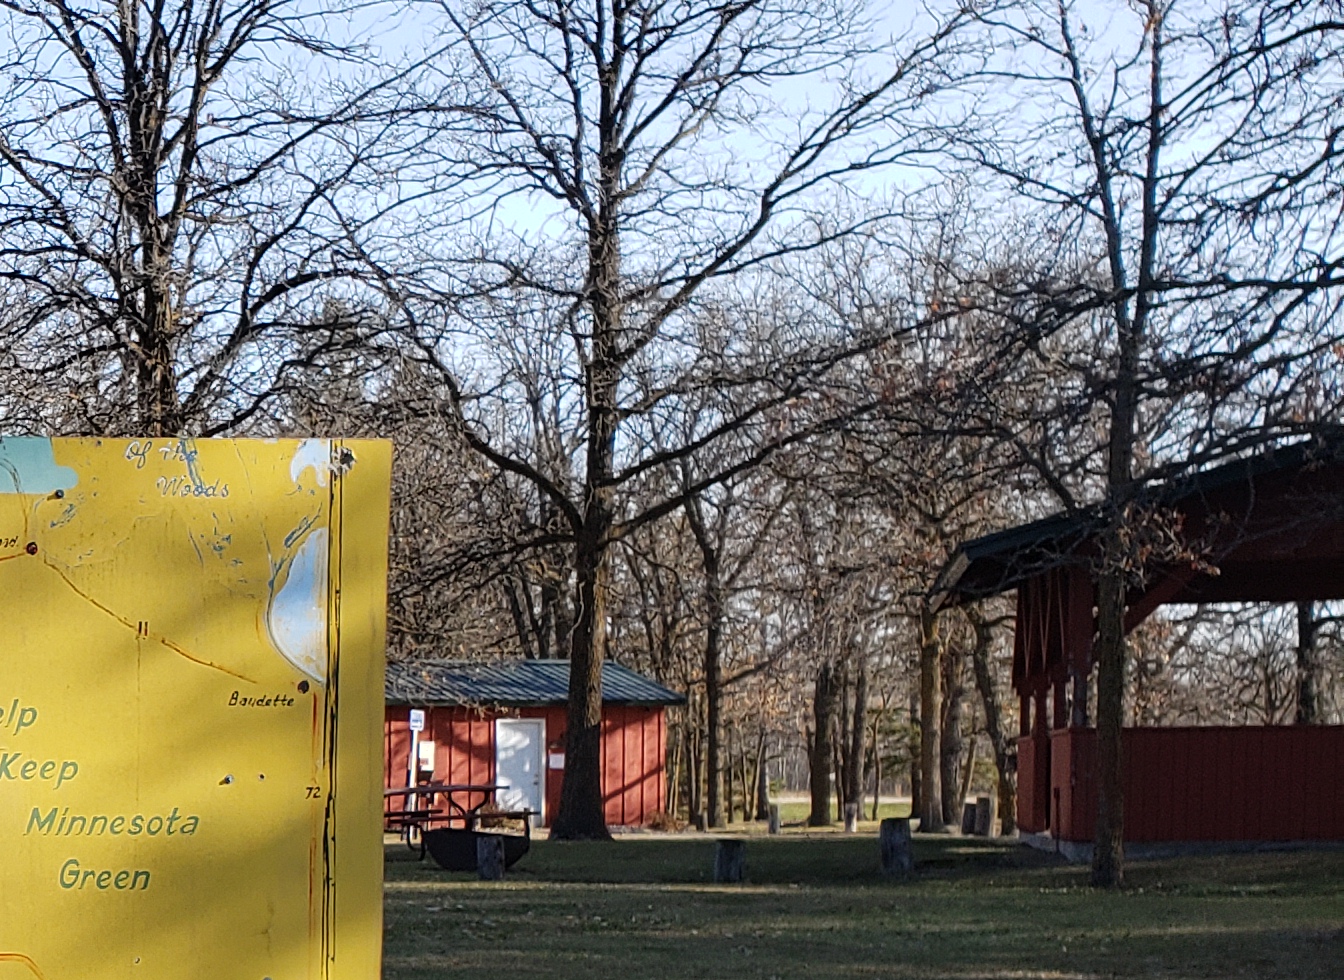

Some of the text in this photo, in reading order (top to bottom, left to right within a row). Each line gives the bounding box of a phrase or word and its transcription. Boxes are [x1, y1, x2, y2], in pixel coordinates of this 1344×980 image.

[157, 475, 231, 498] Woods
[228, 691, 294, 707] Baudette
[305, 787, 321, 800] 72
[23, 807, 200, 836] Minnesota
[59, 859, 151, 890] Green
